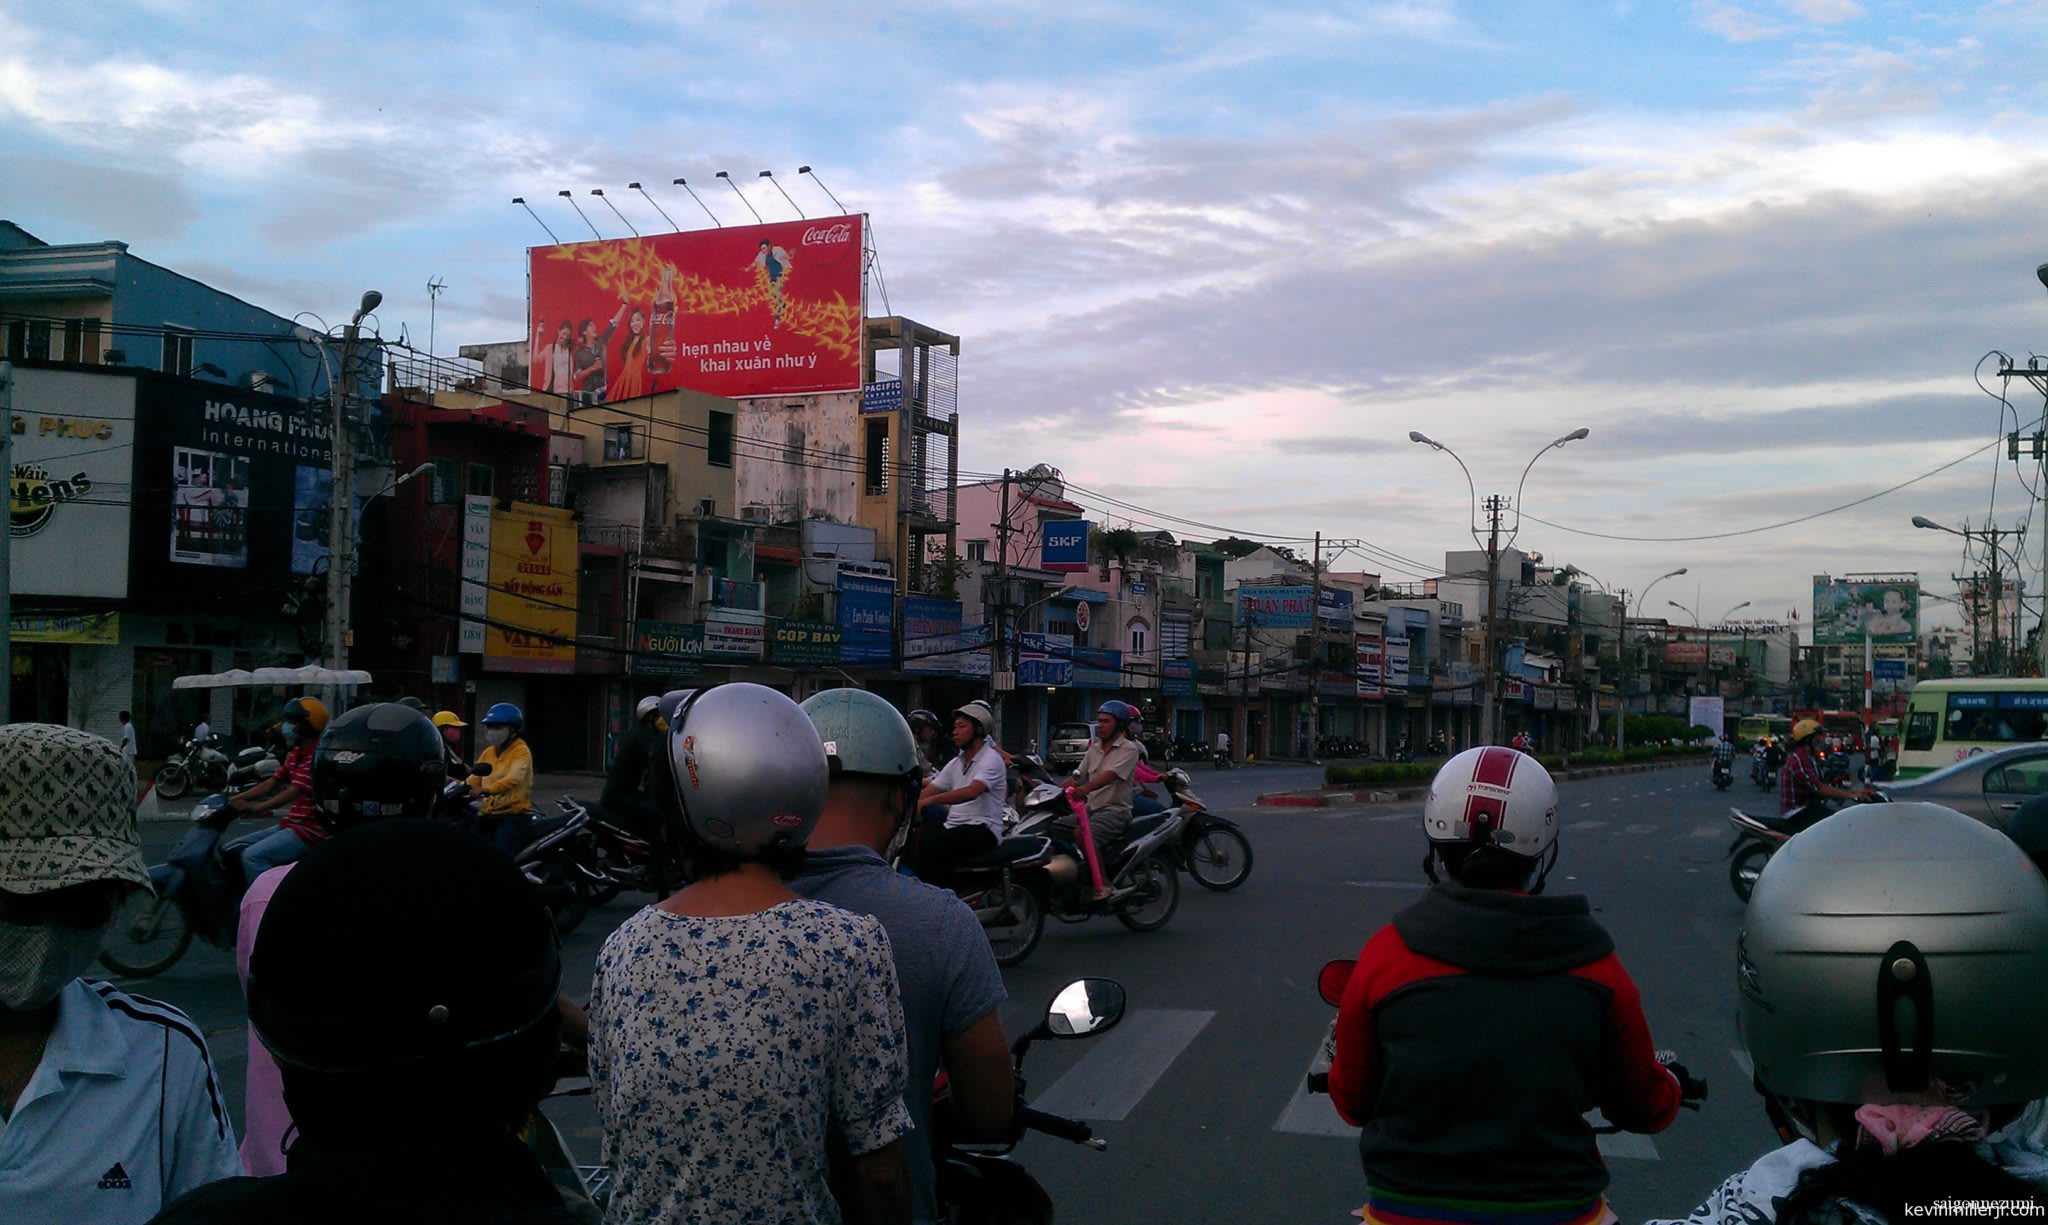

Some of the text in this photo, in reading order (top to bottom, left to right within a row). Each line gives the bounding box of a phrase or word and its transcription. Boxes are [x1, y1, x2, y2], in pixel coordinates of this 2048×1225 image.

[682, 335, 772, 358] hẹn nhau về
[700, 351, 818, 373] khai xuân như ý
[864, 382, 901, 392] PACIFIC
[204, 399, 283, 433] HOANG
[202, 427, 333, 462] internationa
[1048, 536, 1082, 547] SKF
